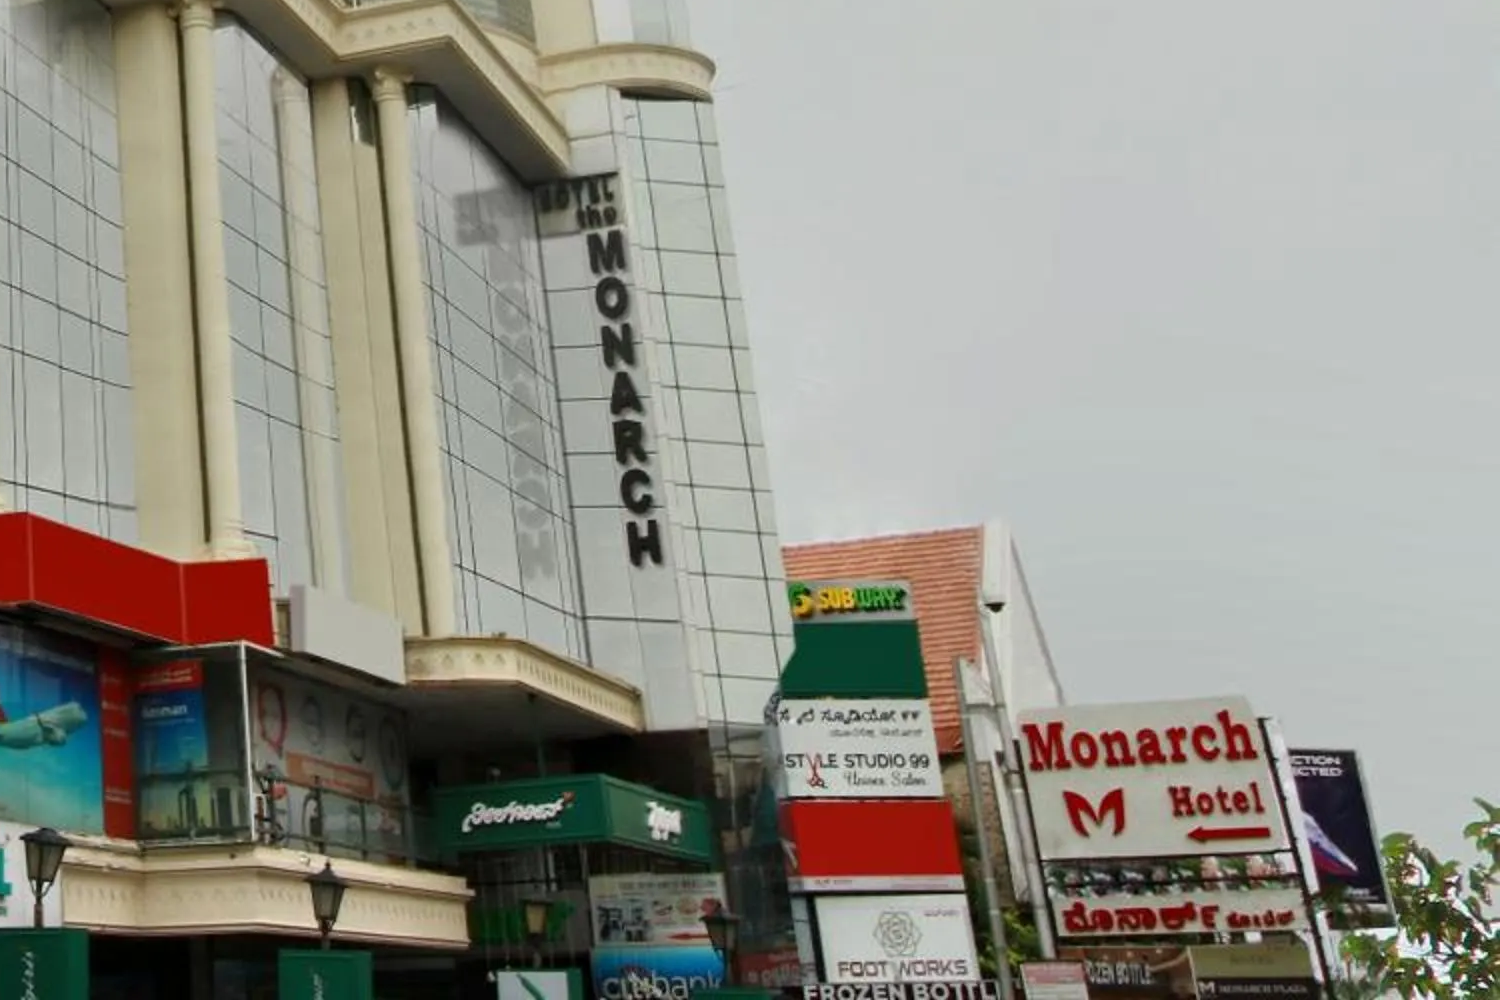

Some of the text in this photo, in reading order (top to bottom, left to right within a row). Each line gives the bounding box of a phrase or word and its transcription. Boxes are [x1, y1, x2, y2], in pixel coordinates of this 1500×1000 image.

[586, 229, 662, 567] MONARCH
[1022, 709, 1258, 771] Monarch
[844, 753, 905, 770] STUDIO
[910, 753, 930, 770] 99
[1291, 755, 1341, 766] CTION
[1168, 782, 1264, 817] Hotel
[803, 983, 999, 1000] FROZEN BOTTL
